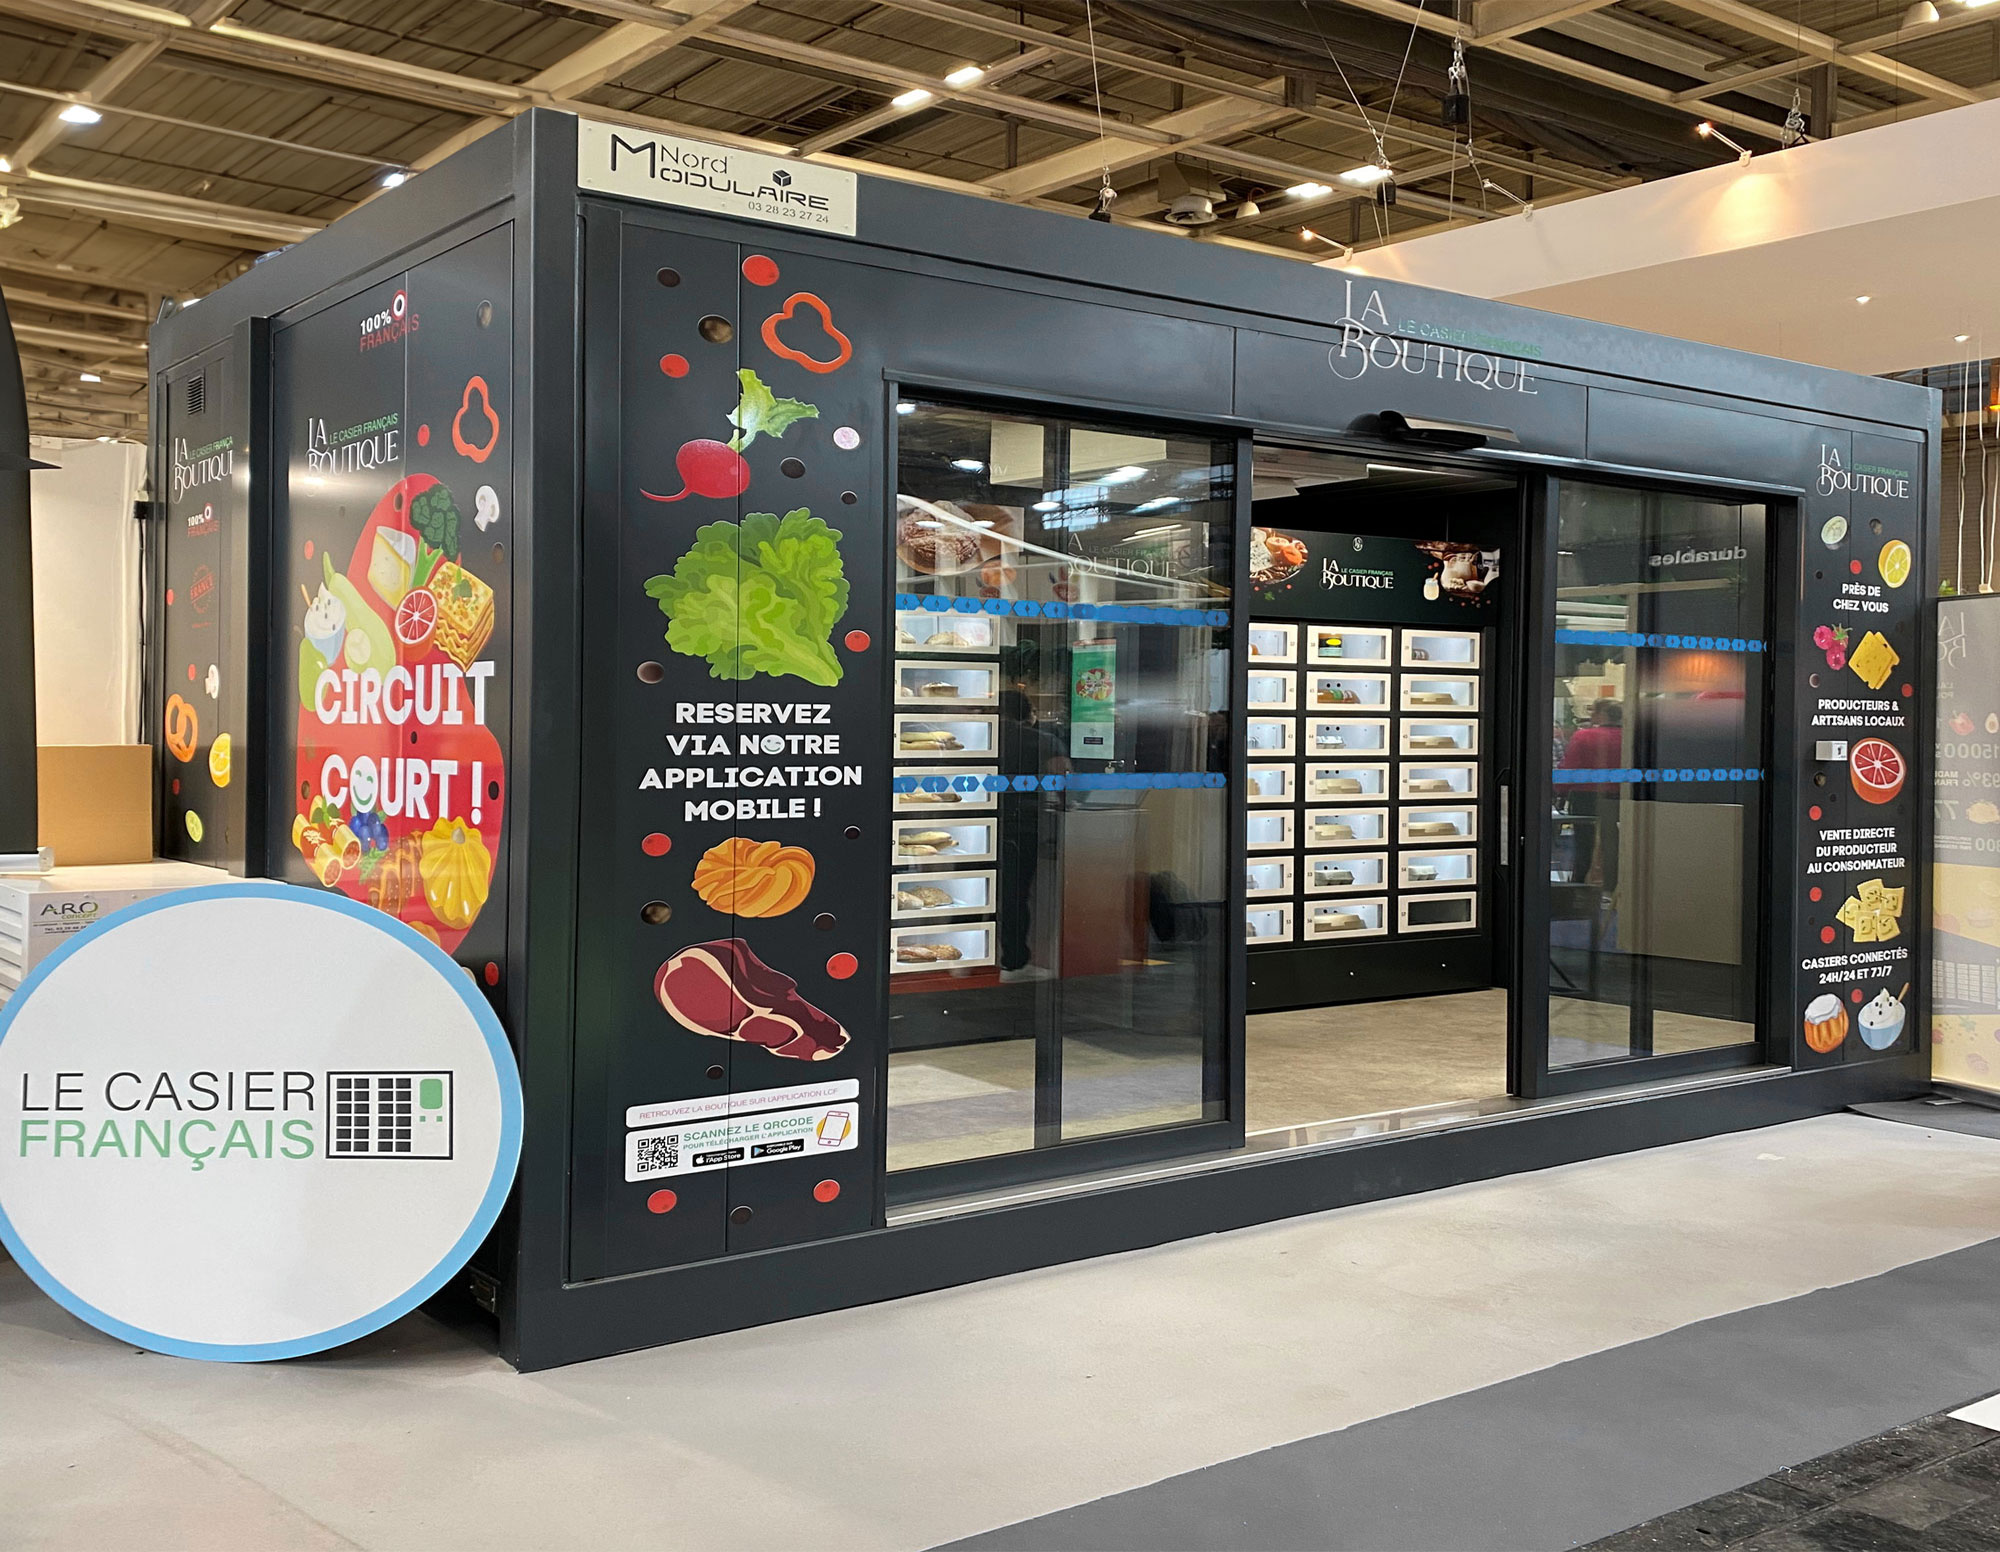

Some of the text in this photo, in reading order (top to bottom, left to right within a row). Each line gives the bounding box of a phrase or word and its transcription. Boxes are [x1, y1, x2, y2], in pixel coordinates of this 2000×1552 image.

[661, 144, 728, 174] Nord
[748, 201, 829, 224] 03 28 23 27 24
[1345, 279, 1389, 325] LA
[359, 314, 420, 352] FRANÇAIS
[360, 309, 391, 335] 100%
[1398, 318, 1416, 333] LE
[1328, 318, 1539, 395] BOUTIQUE
[308, 418, 327, 450] LA
[330, 413, 399, 445] LE CASIER FRANÇAIS
[174, 437, 188, 466] LA
[307, 430, 399, 477] BOUTIQUE
[1821, 444, 1841, 466] LA
[1816, 466, 1909, 498] BOUTIQUE
[1322, 558, 1339, 571] LA
[1319, 571, 1394, 590] BOUTIQUE
[1842, 583, 1881, 597] PRÈS DE
[1833, 598, 1889, 613] CHEZ VOUS
[314, 660, 495, 726] CIRCUIT
[1818, 699, 1899, 712] PRODUCTEURS &
[675, 702, 832, 724] RESERVEZ
[1811, 715, 1905, 727] ARTISANS LOCAUX
[666, 734, 840, 755] VIA NOTRE
[320, 754, 482, 825] COURT !
[638, 765, 862, 790] APPLICATION
[684, 797, 822, 822] MOBILE !
[1819, 827, 1896, 841] VENTE DIRECTE
[1816, 842, 1897, 857] DU PRODUCTEUR
[1807, 857, 1905, 874] AU CONSOMMATEUR
[1801, 946, 1908, 971] CASIERS CONNECTÉS
[1819, 968, 1856, 984] 24H/24
[1857, 968, 1869, 980] ET
[22, 1071, 315, 1112] LE CASIER
[639, 1088, 838, 1120] RETROUVEZ LA BOUTIQUE SUR L'APPLICATION LCF
[683, 1115, 814, 1142] SCANNEZ LE QRCODE
[19, 1118, 315, 1172] FRANÇAIS
[683, 1142, 705, 1150] POUR
[705, 1134, 760, 1148] TÉLÉCHARGER
[766, 1146, 788, 1154] Google
[723, 1153, 741, 1161] Store
